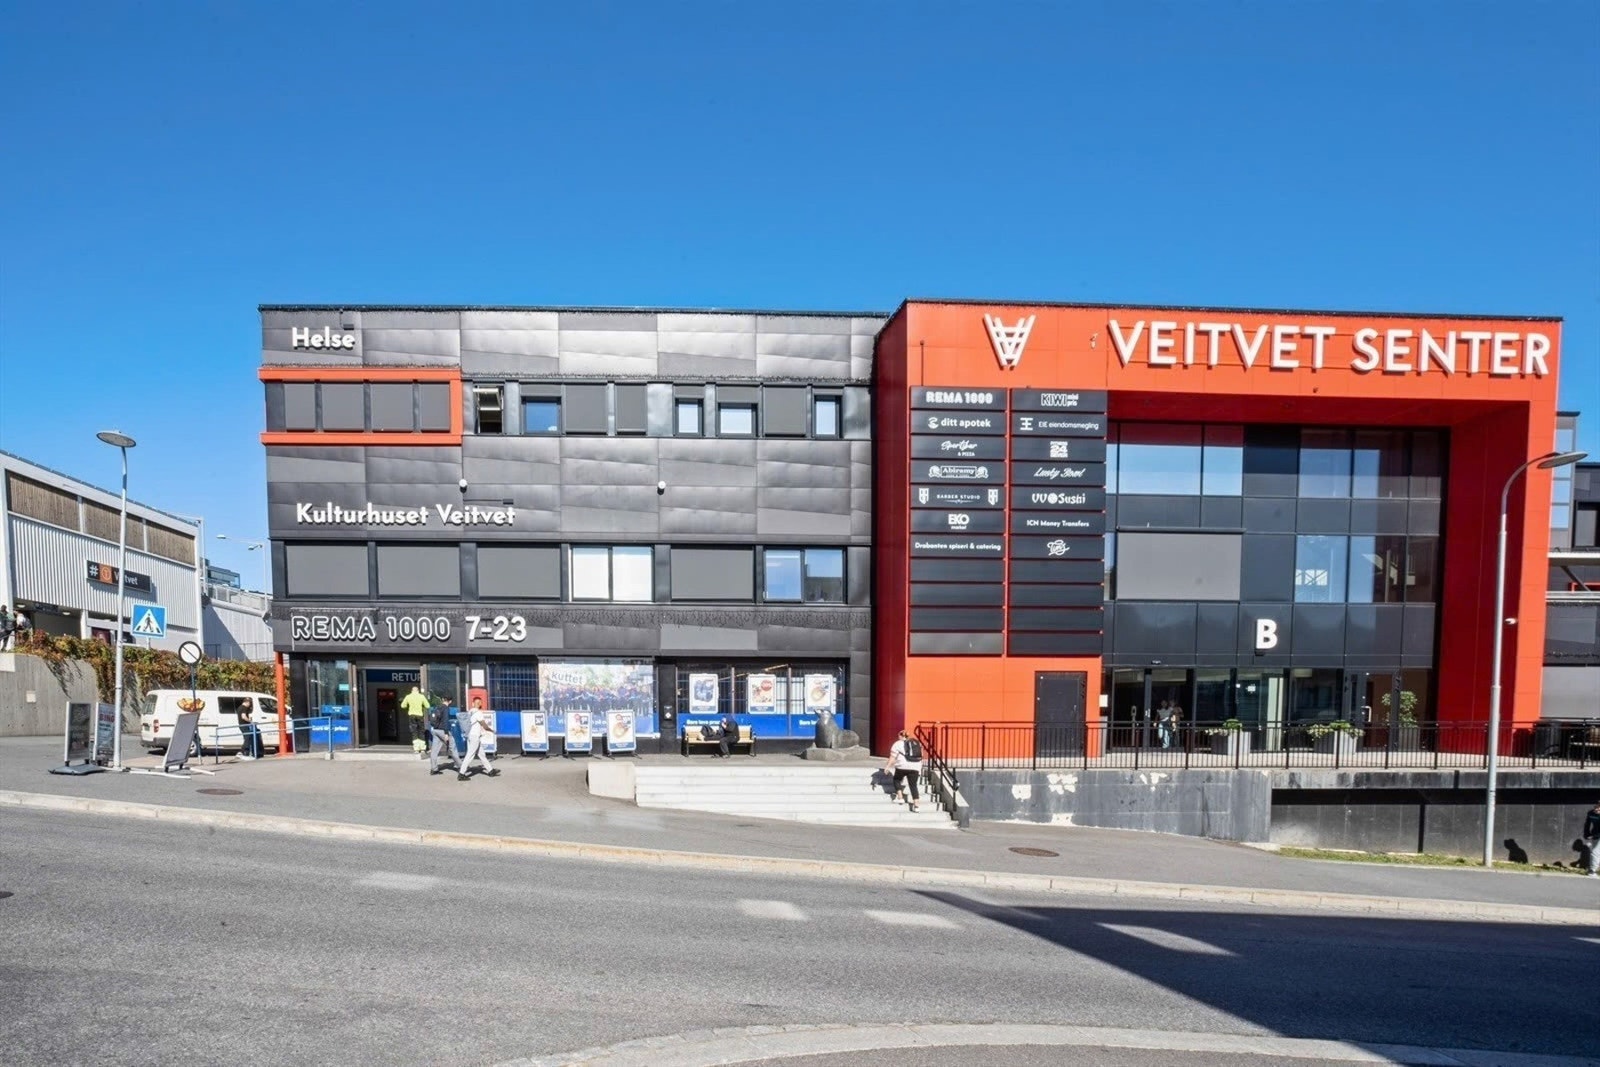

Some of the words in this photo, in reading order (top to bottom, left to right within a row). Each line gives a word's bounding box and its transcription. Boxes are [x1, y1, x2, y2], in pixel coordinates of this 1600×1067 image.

[291, 326, 356, 348] Helse
[1108, 319, 1337, 368] VEITVET
[1351, 327, 1551, 375] SENTER
[925, 391, 963, 404] REMA
[964, 392, 993, 404] 1000
[1041, 393, 1067, 407] KIWI
[940, 418, 958, 427] ditt
[959, 418, 991, 429] apotek
[1048, 422, 1099, 431] eiendomsmegling
[1034, 467, 1061, 480] Lucky
[1058, 493, 1086, 505] Sushi
[296, 501, 429, 525] Kulturhuset
[435, 503, 516, 526] Veitvet
[948, 513, 970, 525] EKO
[1040, 520, 1060, 528] Money
[975, 543, 1002, 551] catering
[291, 615, 377, 641] REMA
[384, 616, 451, 641] 1000
[465, 615, 527, 642] 7-23
[1256, 618, 1279, 650] B
